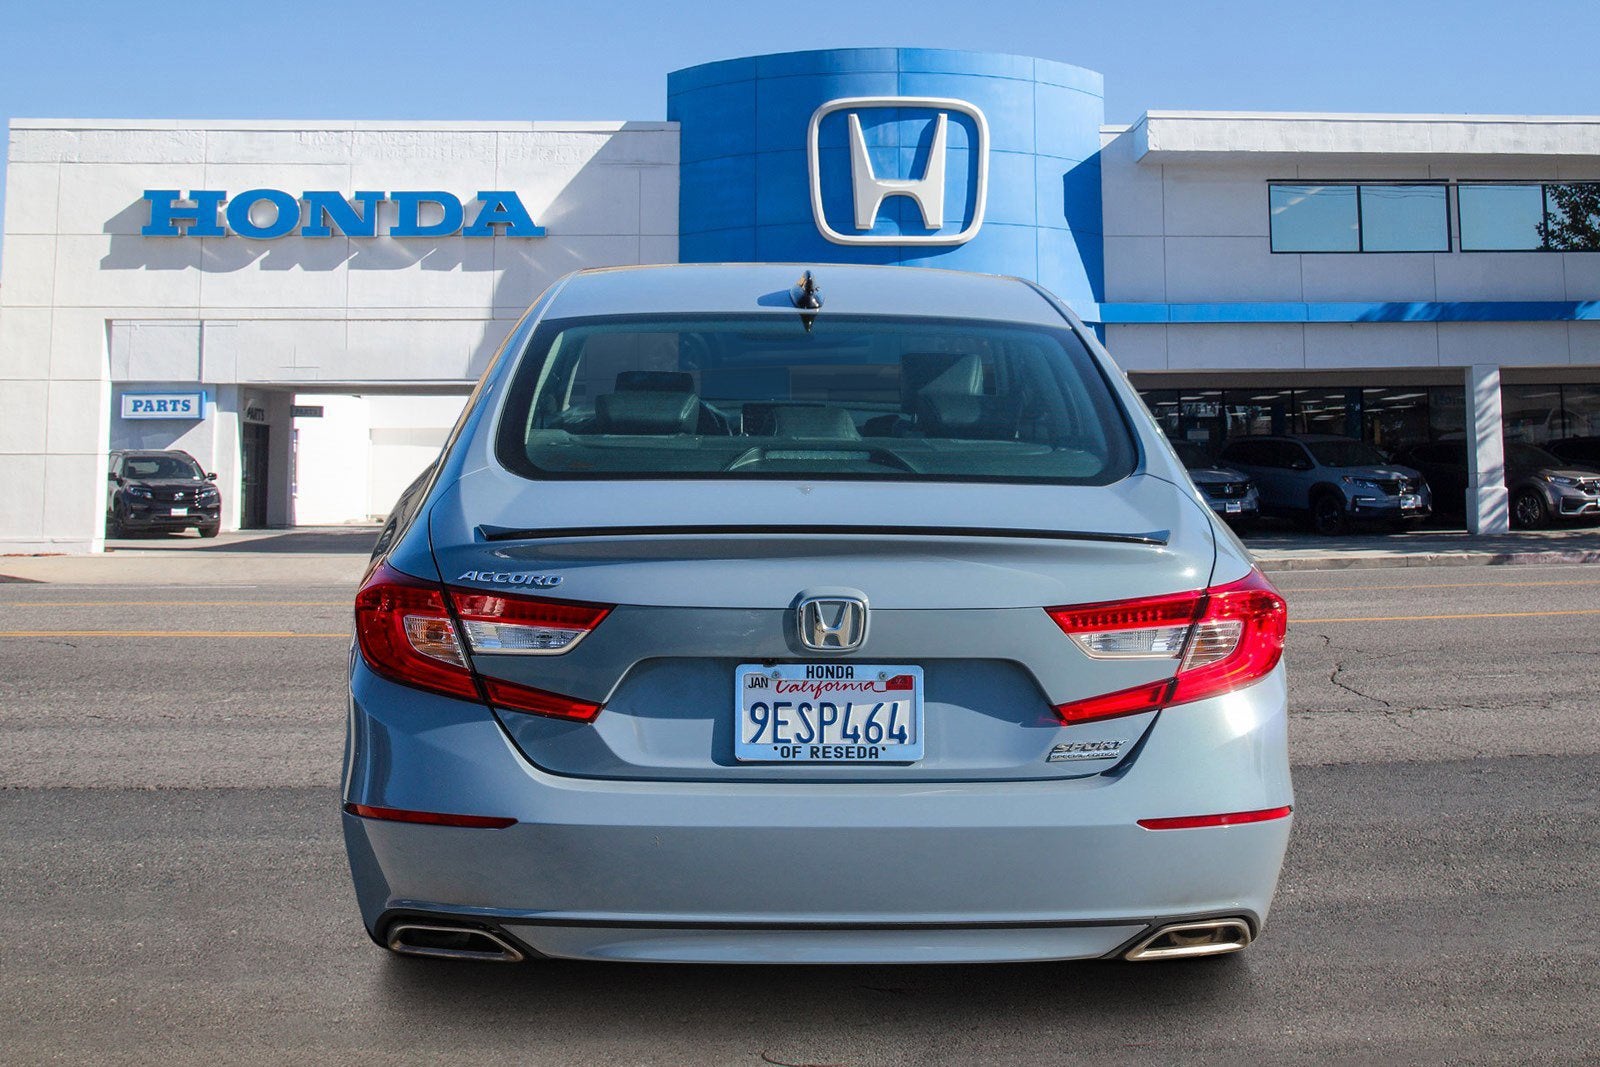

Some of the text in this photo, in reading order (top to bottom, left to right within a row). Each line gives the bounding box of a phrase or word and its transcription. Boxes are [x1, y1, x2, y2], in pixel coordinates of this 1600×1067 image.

[141, 189, 548, 240] HONDA
[132, 399, 191, 413] PARTS
[458, 570, 564, 585] ACCORD
[806, 665, 854, 679] HONDA
[748, 677, 769, 688] JAN
[775, 680, 887, 700] California
[749, 702, 908, 744] 9ESP464
[780, 746, 879, 759] OF RESEDA
